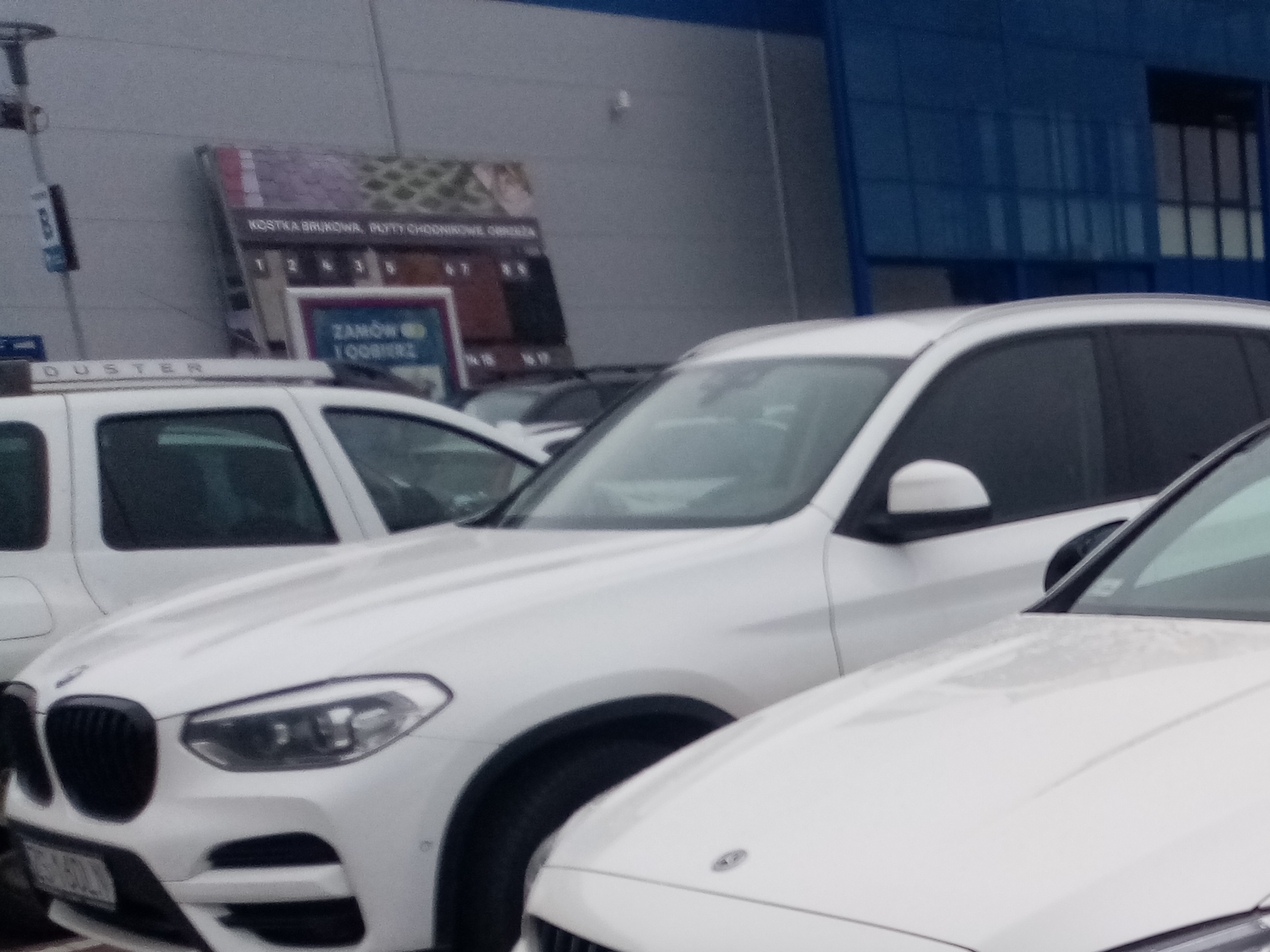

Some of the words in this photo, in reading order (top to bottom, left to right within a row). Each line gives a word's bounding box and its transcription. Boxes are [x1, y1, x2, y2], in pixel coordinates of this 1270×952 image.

[249, 219, 300, 232] KOSTKA
[331, 319, 397, 341] ZAMÓW
[42, 362, 203, 378] DUSTER
